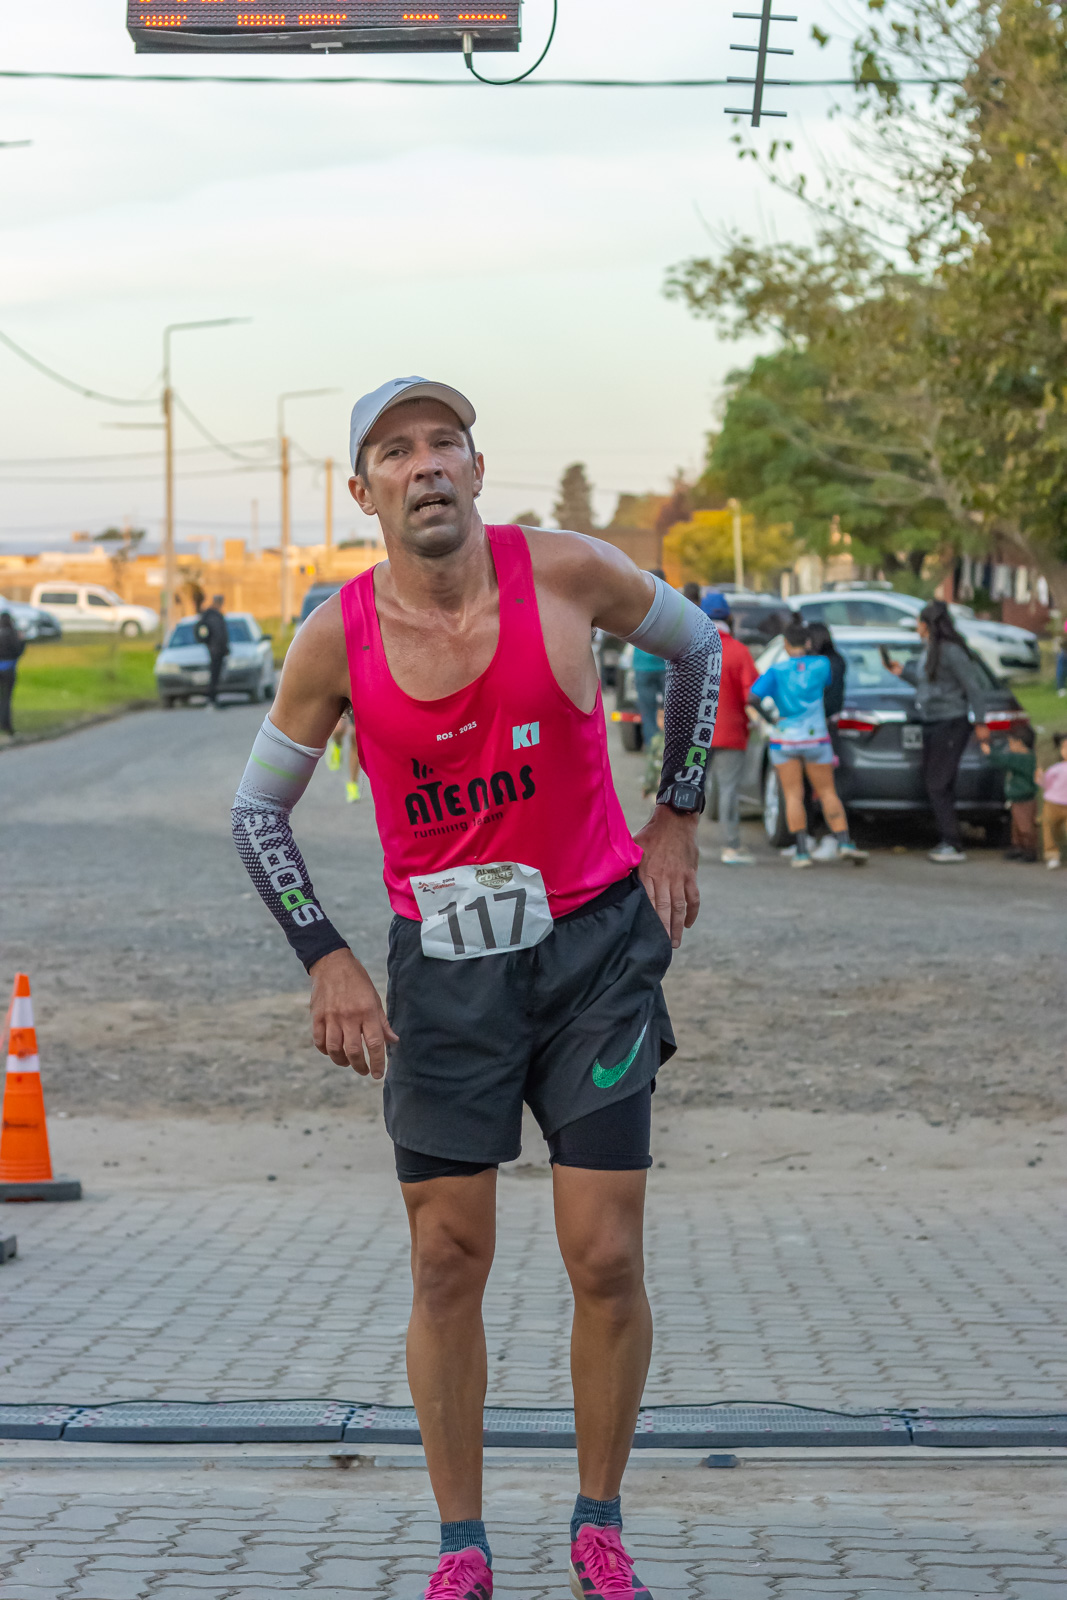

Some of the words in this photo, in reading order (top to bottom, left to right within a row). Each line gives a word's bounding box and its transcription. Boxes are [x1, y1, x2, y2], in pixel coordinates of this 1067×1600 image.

[436, 731, 453, 742] ROS
[458, 720, 478, 734] 2025
[405, 765, 536, 825] ATENAS
[414, 821, 468, 839] running
[472, 811, 503, 827] team
[244, 814, 325, 927] SPORTS
[438, 888, 527, 955] 117
